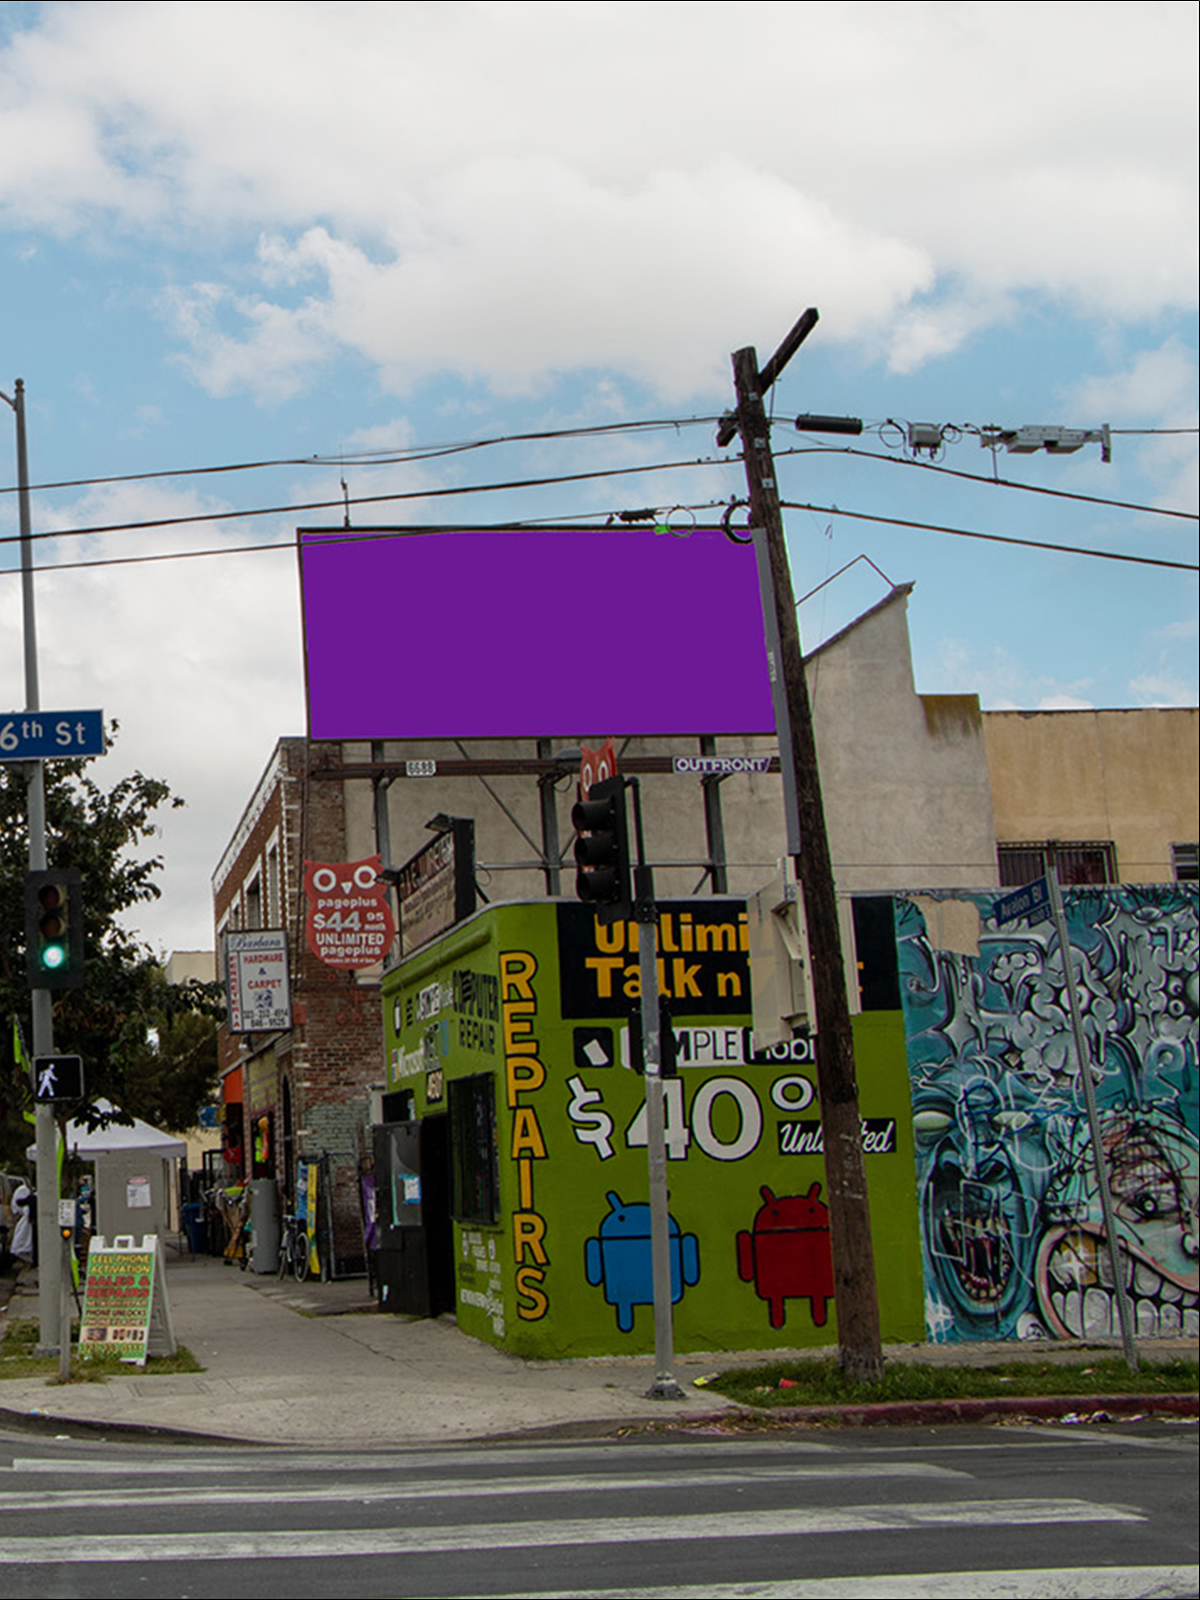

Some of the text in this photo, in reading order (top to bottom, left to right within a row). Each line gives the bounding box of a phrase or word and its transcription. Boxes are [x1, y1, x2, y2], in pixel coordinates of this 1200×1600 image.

[56, 721, 86, 746] St
[676, 758, 766, 771] OUTFRONT
[317, 896, 378, 910] pagoplus
[313, 911, 384, 932] $44 95
[316, 933, 385, 945] UNLIMITED
[320, 944, 381, 957] pagoplus
[243, 953, 283, 964] HARDWARE
[247, 979, 282, 990] CARPET
[716, 971, 742, 997] n
[672, 1030, 738, 1061] MPLE
[499, 950, 550, 1322] REPAIRS
[91, 1254, 150, 1264] CELL PHONE
[90, 1264, 150, 1274] ACTIVATION
[88, 1276, 150, 1286] SALES &
[86, 1287, 149, 1299] REPAIRS
